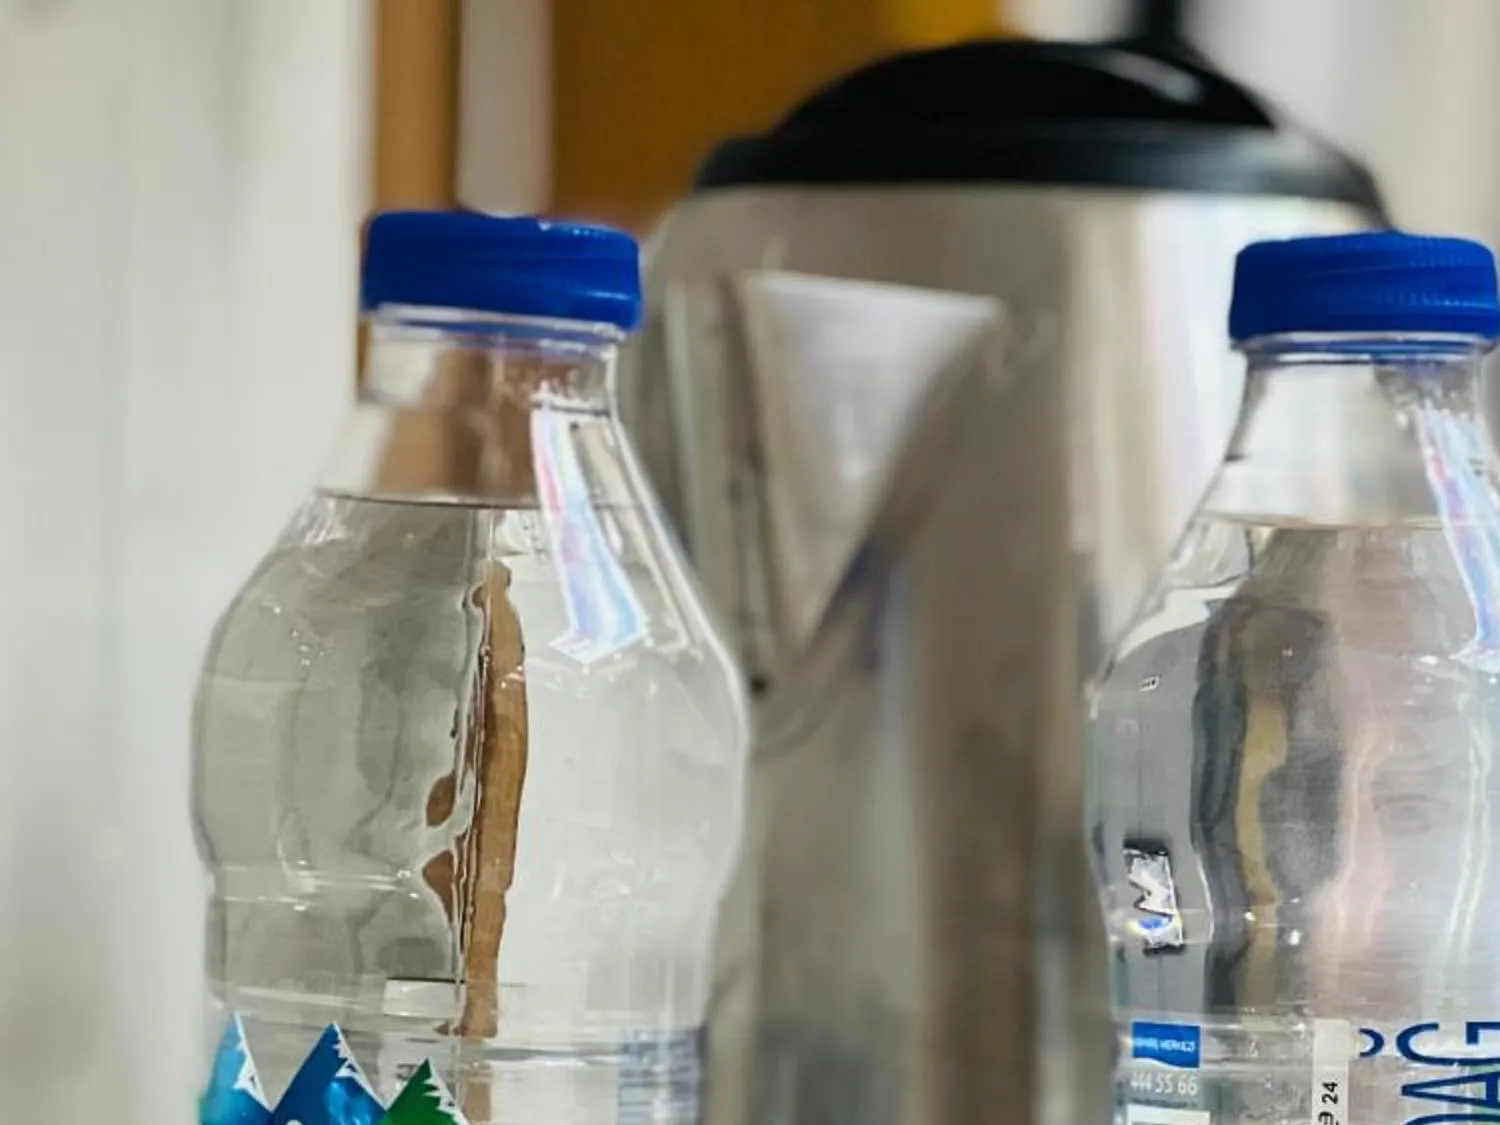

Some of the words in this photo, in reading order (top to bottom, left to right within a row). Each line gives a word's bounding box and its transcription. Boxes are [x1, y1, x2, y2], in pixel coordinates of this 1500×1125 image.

[1155, 1073, 1173, 1093] 55
[1178, 1075, 1198, 1096] 66
[1321, 1081, 1339, 1105] 24
